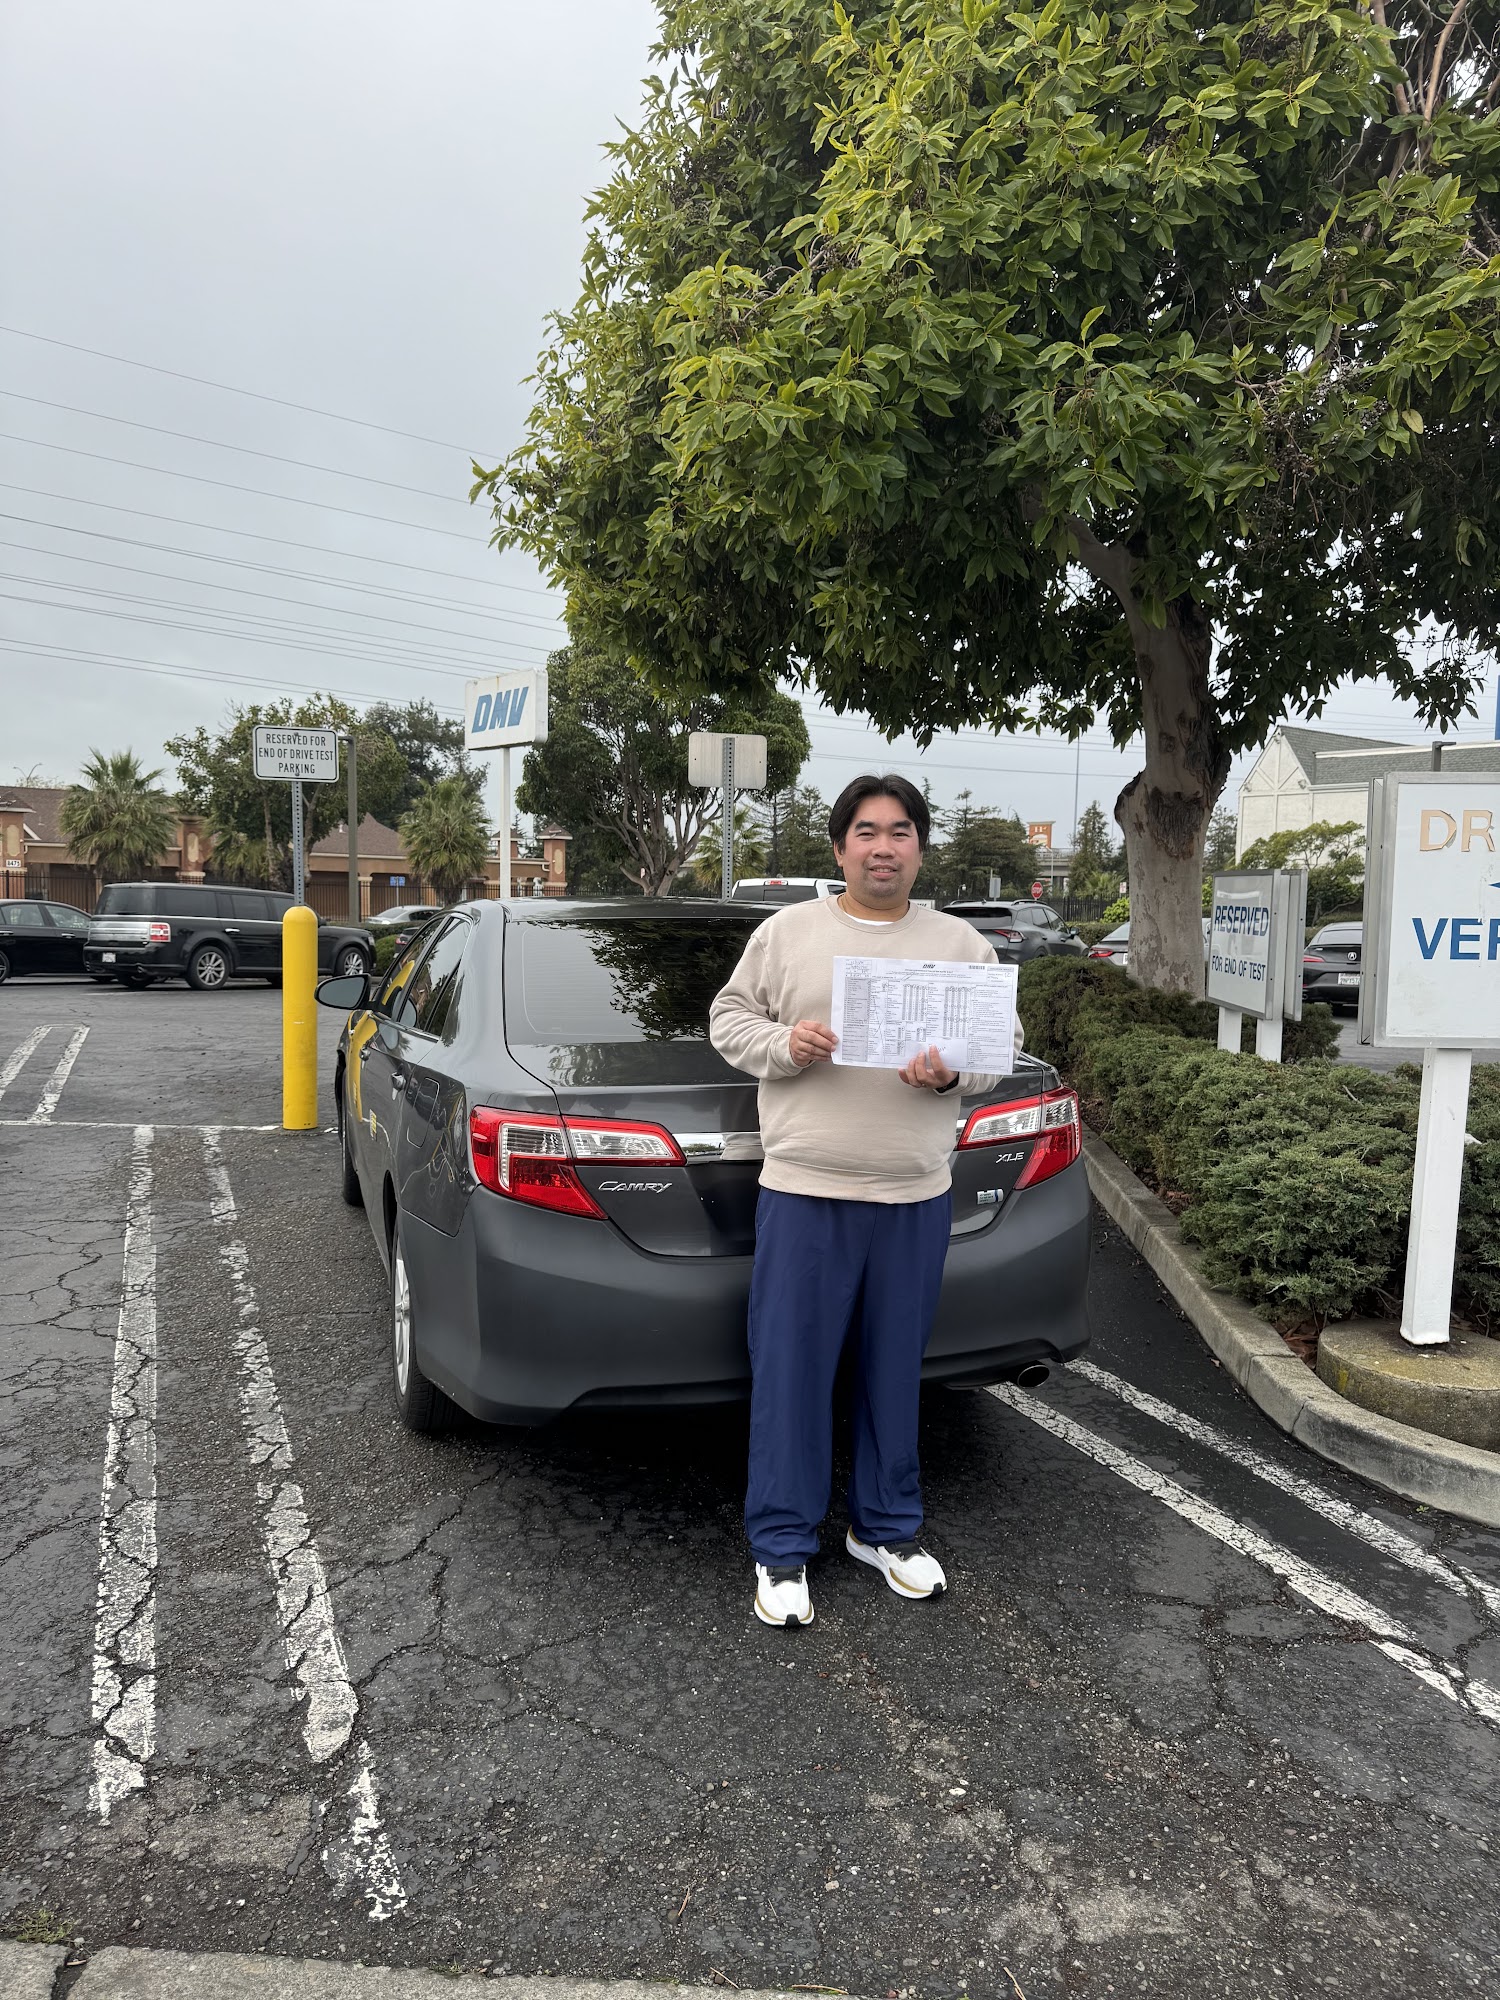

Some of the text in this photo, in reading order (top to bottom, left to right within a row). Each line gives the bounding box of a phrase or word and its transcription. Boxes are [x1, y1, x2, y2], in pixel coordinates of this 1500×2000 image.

[472, 686, 529, 733] DMV
[266, 733, 326, 746] RESERVED FOR
[259, 747, 334, 761] END OF DRIVE TEST
[278, 762, 316, 774] PARKING
[1214, 905, 1269, 937] RESERVED
[1212, 955, 1266, 981] FOR END OF TEST
[995, 1151, 1025, 1164] XLE
[598, 1180, 673, 1194] CAMRY
